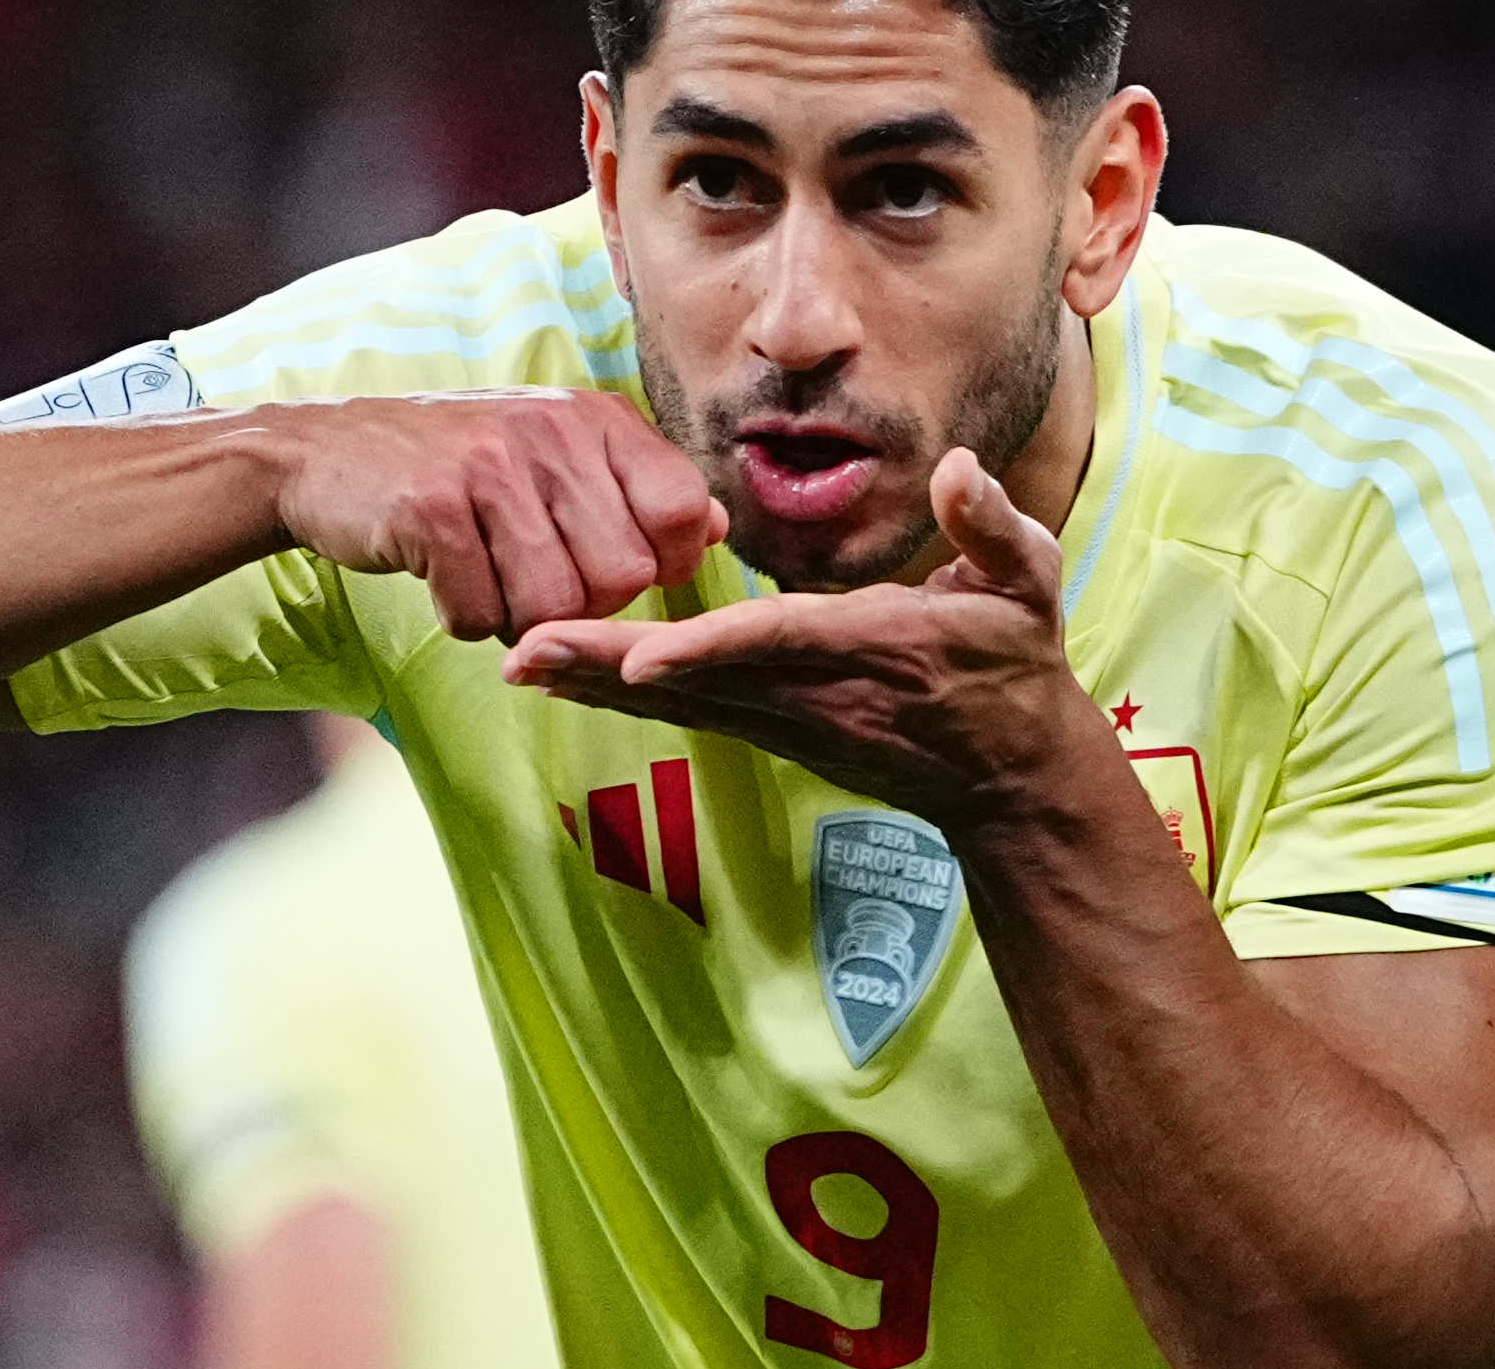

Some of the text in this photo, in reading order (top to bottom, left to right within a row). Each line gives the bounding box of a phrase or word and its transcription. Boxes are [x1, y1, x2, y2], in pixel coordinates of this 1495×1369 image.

[867, 825, 918, 854] UEFA
[828, 840, 953, 887] EUROPEAN
[824, 864, 951, 912] CHAMPIONS
[836, 971, 902, 1008] 2024
